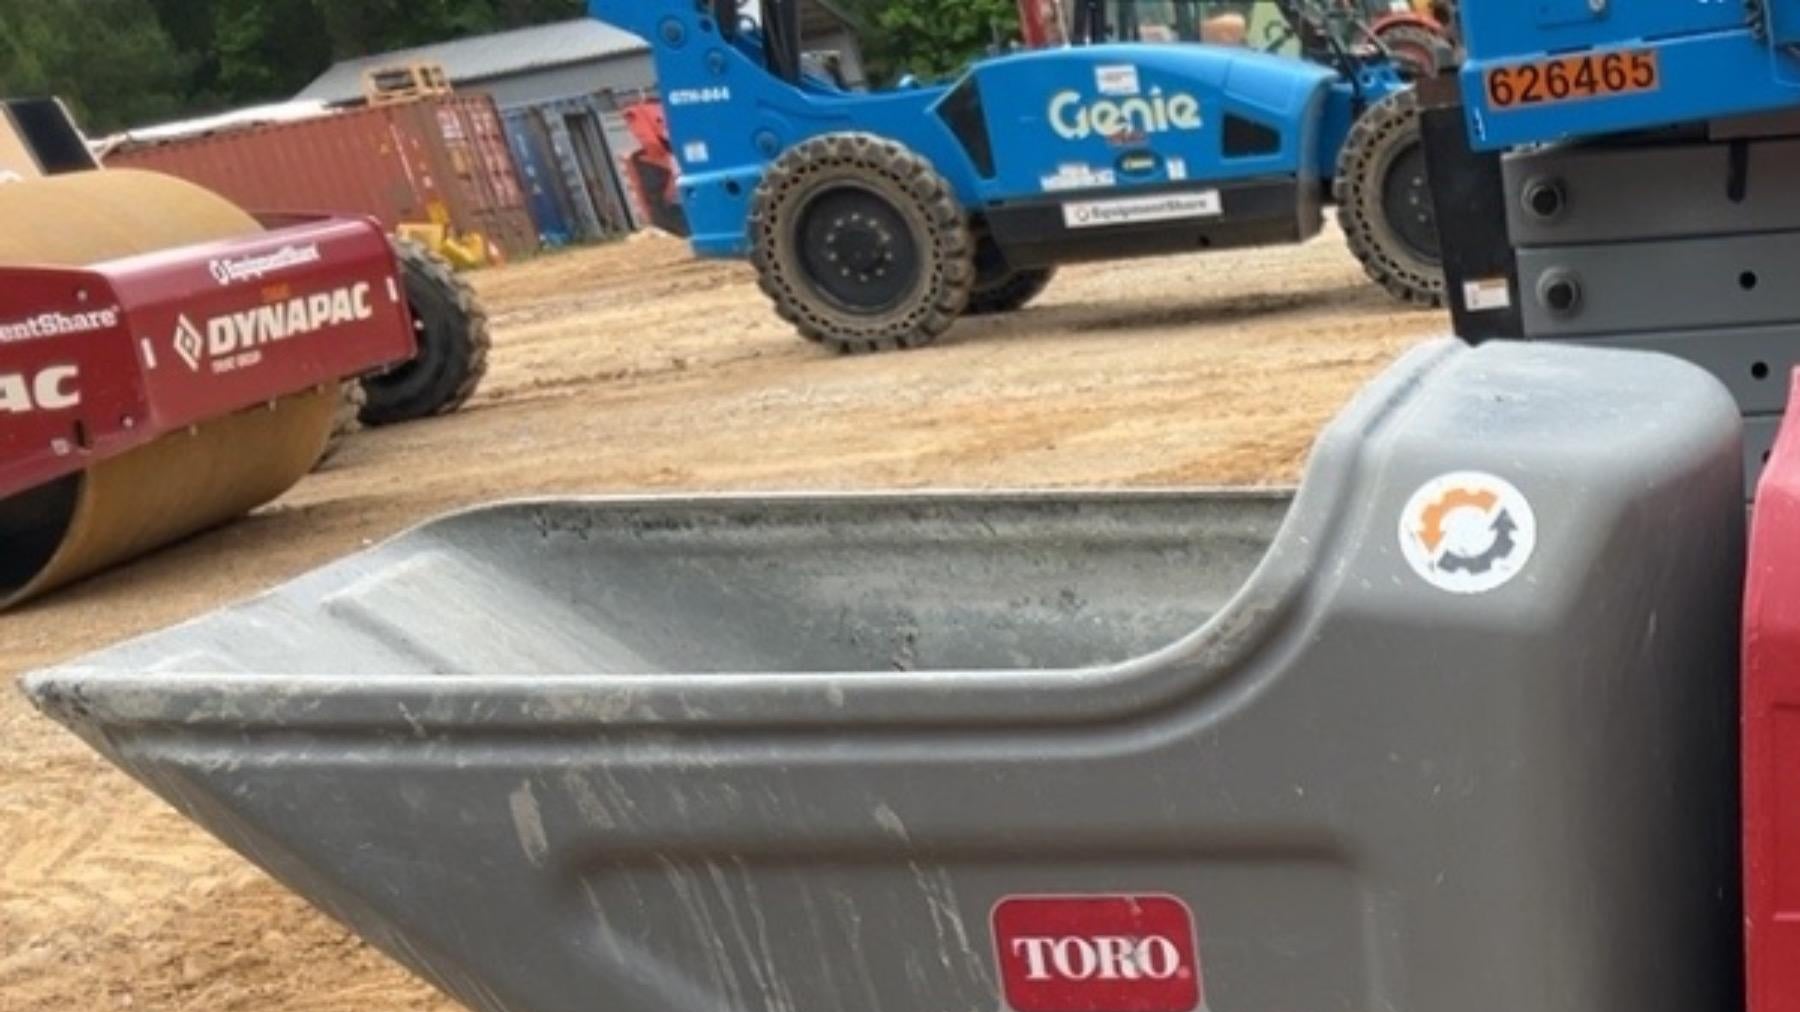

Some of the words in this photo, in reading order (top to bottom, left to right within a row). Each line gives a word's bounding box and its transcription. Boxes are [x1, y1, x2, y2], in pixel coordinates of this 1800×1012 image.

[1489, 53, 1655, 107] 626465
[1049, 85, 1203, 140] Genie
[207, 281, 372, 356] DYNAPAC
[1012, 935, 1181, 980] TORO
